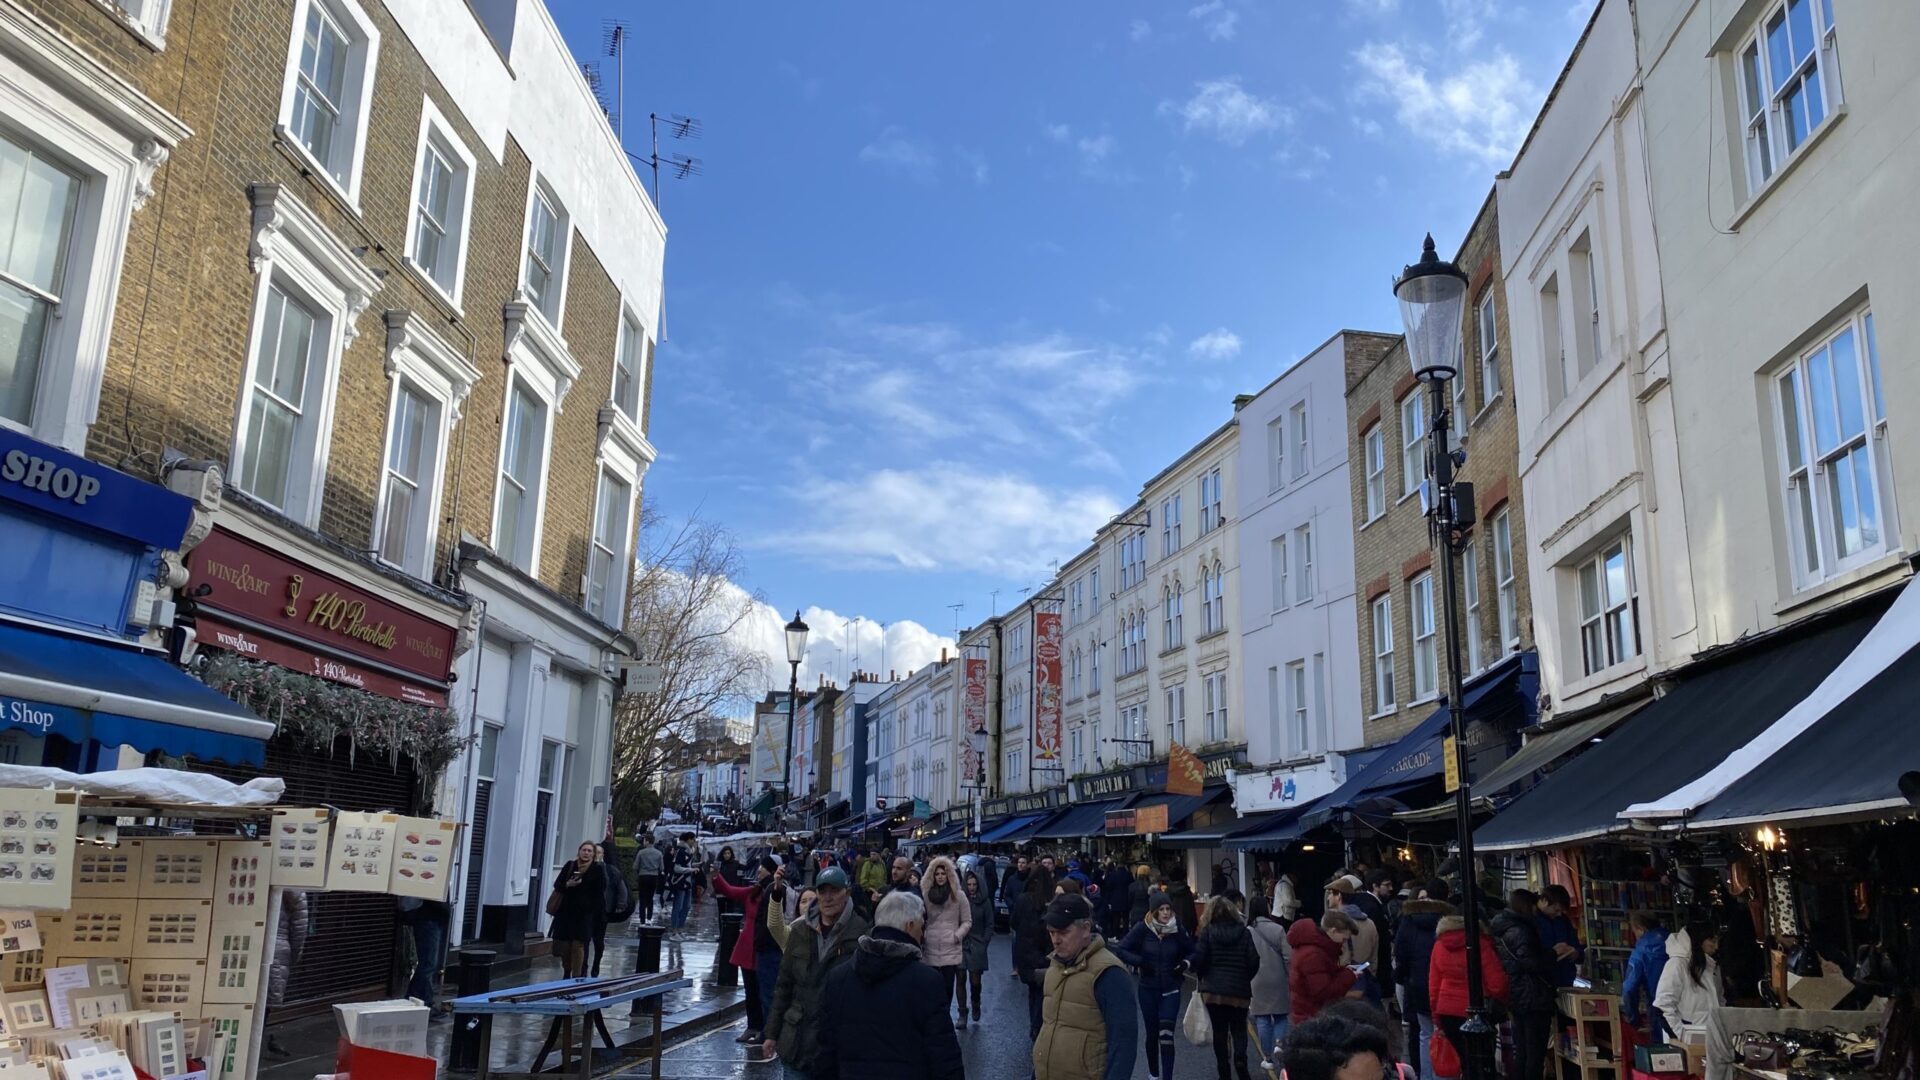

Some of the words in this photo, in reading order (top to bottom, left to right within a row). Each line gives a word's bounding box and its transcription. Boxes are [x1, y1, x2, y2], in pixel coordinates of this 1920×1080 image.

[2, 449, 101, 505] SHOP
[307, 591, 347, 630] 140
[343, 600, 398, 650] Portobello
[324, 662, 339, 679] 140
[10, 701, 54, 732] Shop
[12, 919, 33, 930] VISA
